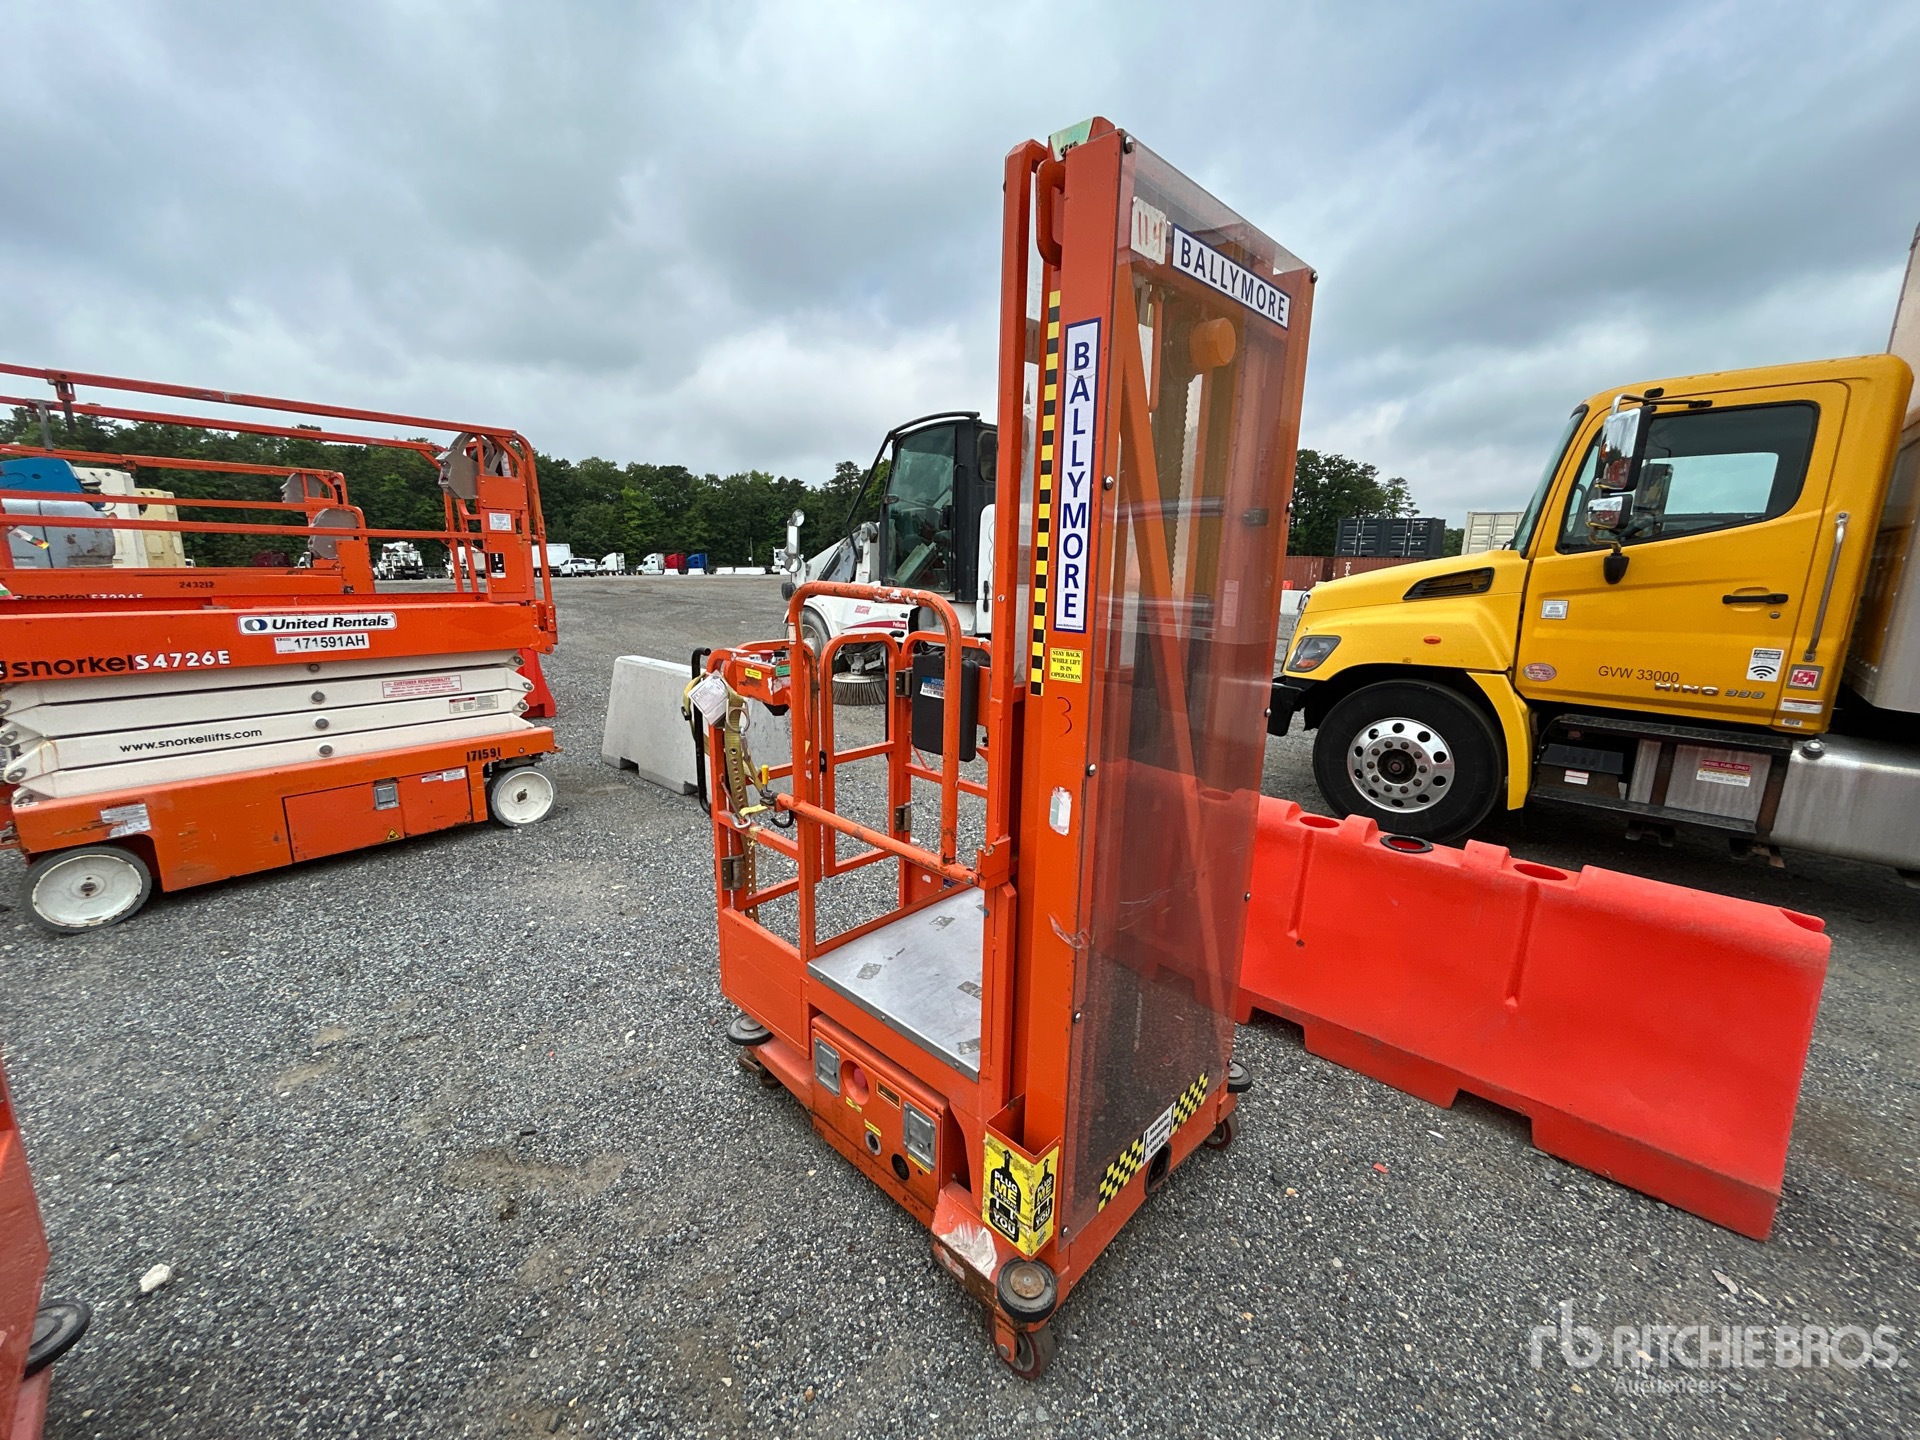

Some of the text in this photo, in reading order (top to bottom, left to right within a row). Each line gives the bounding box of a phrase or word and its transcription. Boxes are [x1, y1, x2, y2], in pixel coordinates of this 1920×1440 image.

[1180, 236, 1285, 322] BALLYMORE
[1062, 341, 1090, 619] BALLYMORE
[179, 581, 215, 589] 243212
[272, 615, 389, 630] United Rentals
[294, 634, 366, 649] 171591AH
[1051, 671, 1081, 680] OPERATION
[1598, 665, 1680, 683] GVW 33000
[1654, 682, 1719, 696] HINO
[119, 728, 263, 753] www.snorkellifts.com
[466, 747, 501, 762] 171591
[994, 1170, 1018, 1193] PLUG
[994, 1178, 1017, 1206] ME
[994, 1211, 1016, 1235] YOU
